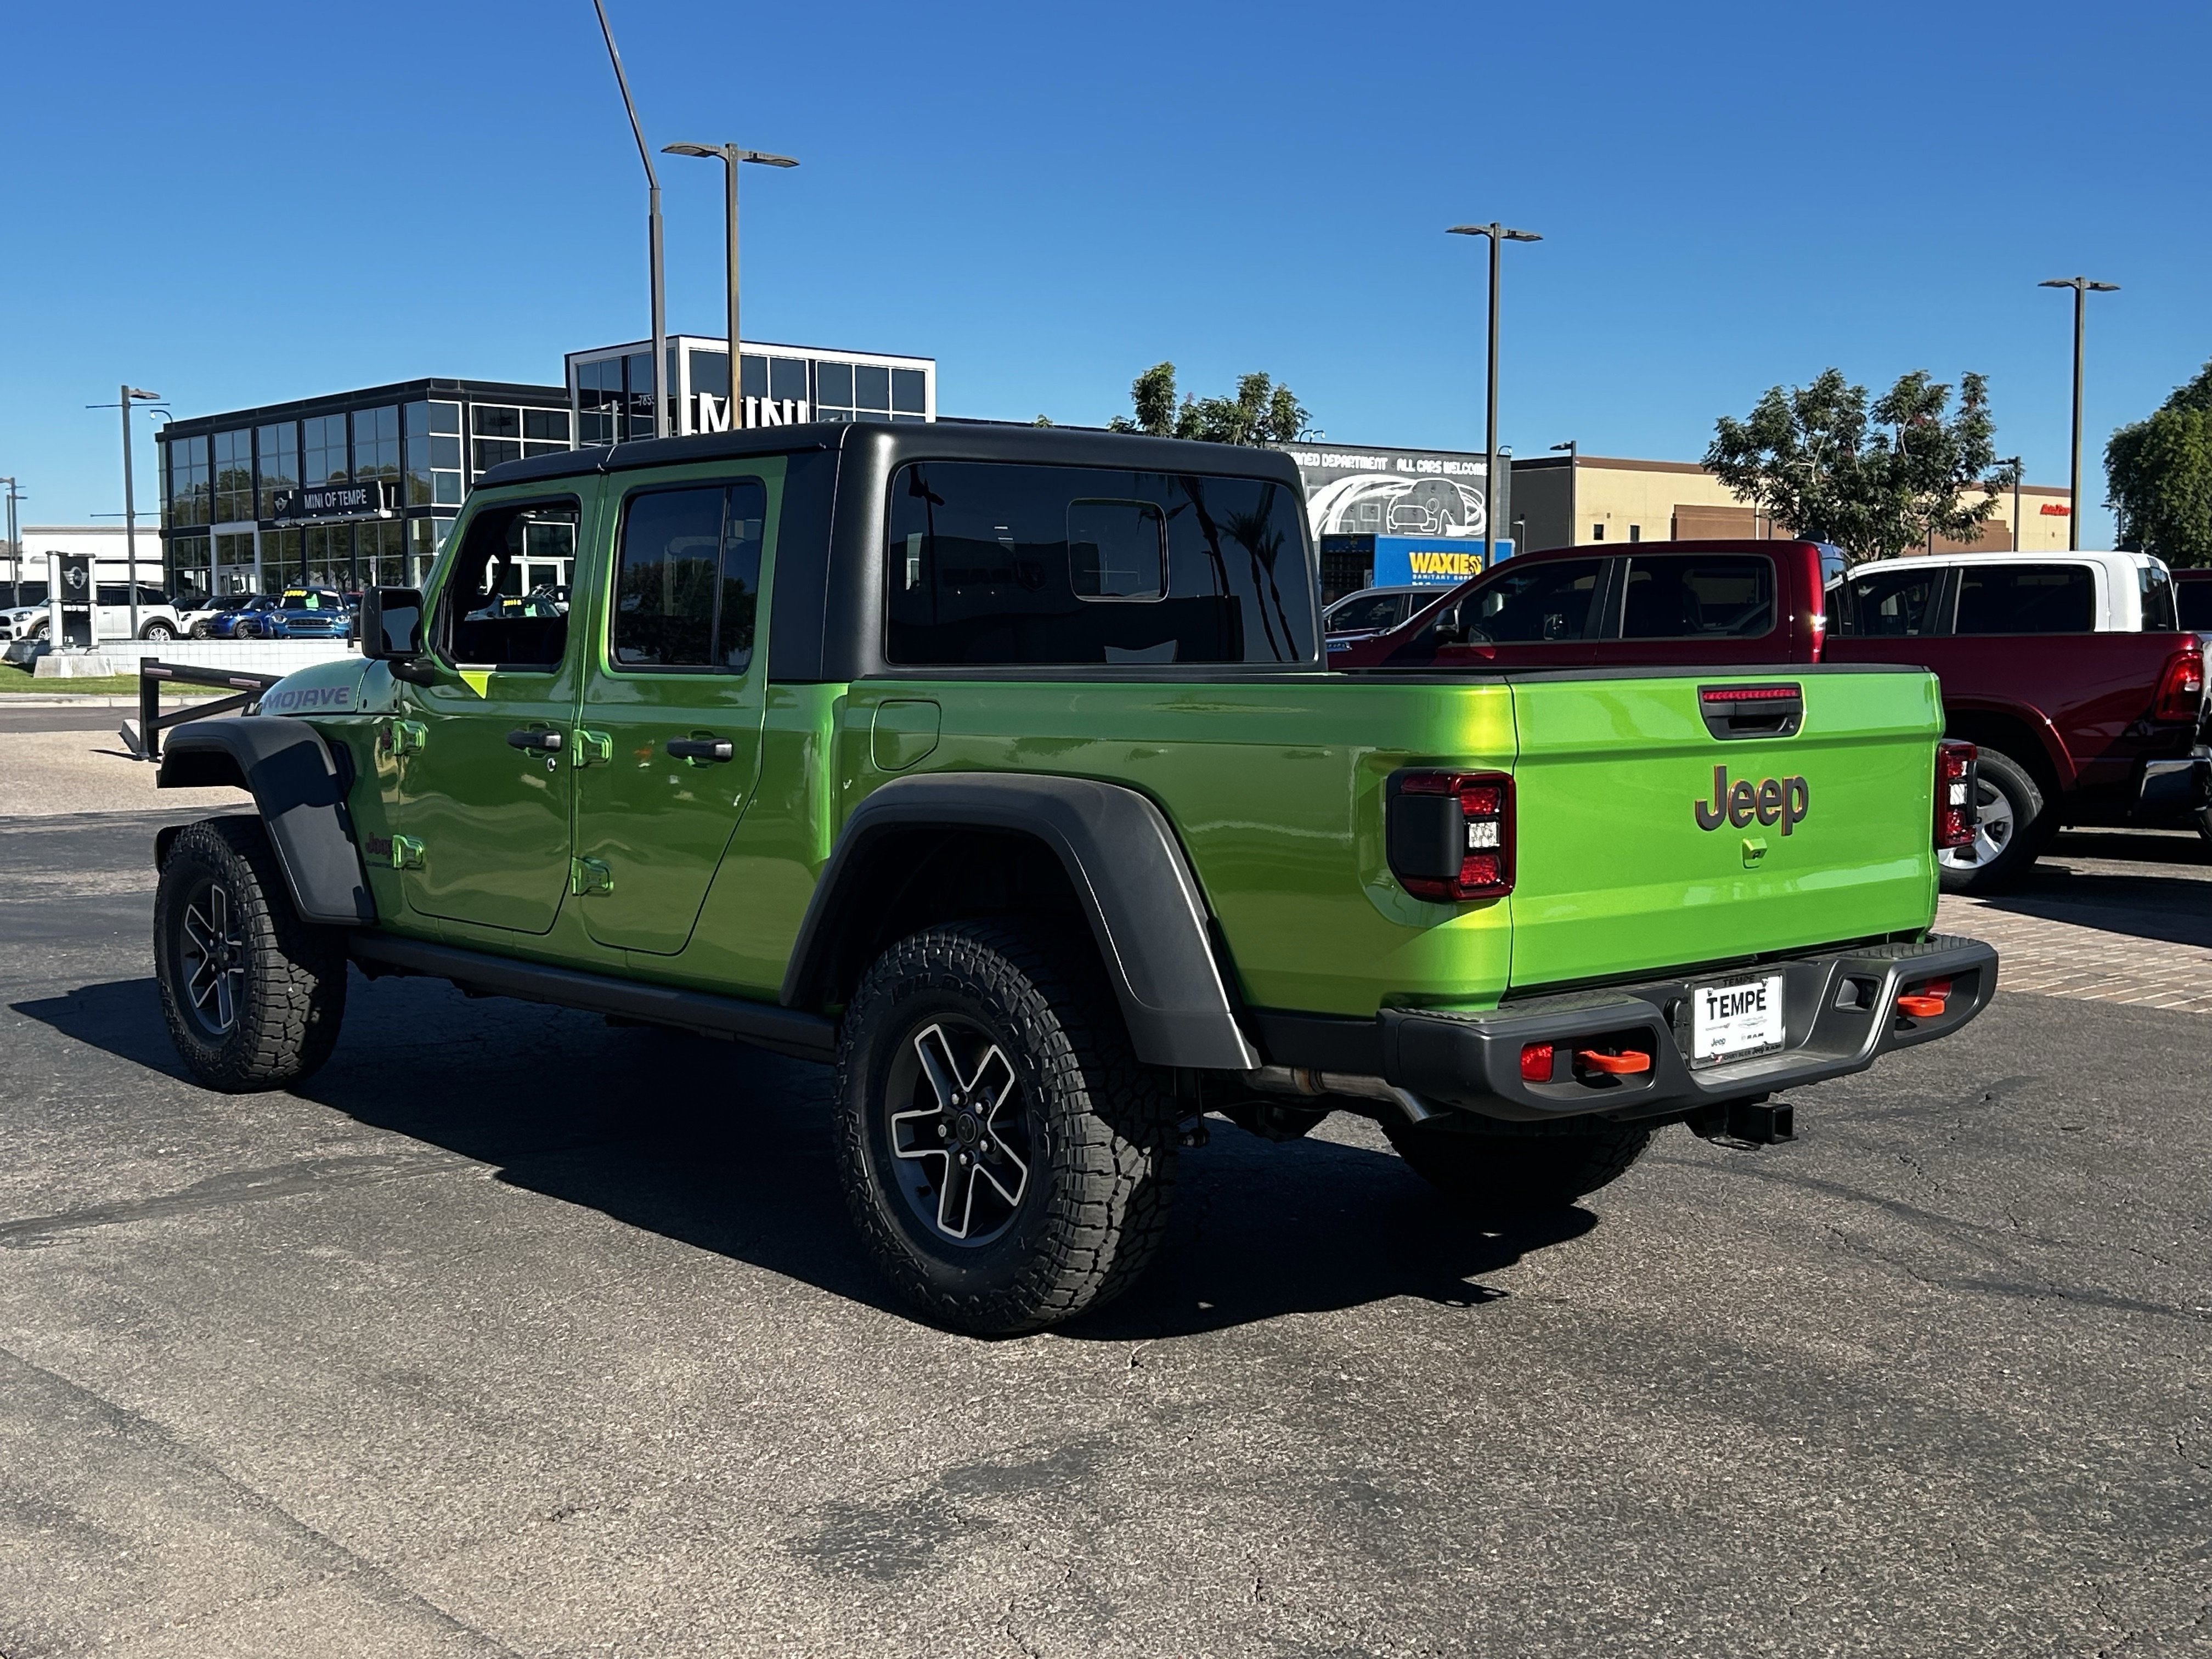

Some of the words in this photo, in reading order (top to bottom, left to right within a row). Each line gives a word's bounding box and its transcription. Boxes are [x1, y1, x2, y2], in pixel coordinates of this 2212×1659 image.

[699, 392, 808, 435] MINI
[1322, 453, 1388, 470] DEPARTMENT
[1397, 458, 1415, 472] ALL
[1417, 460, 1442, 473] CARS
[304, 494, 324, 509] MINI
[325, 492, 337, 507] OF
[337, 489, 368, 506] TEMPE
[263, 687, 350, 710] MOJAVE
[1695, 764, 1809, 837] Jeep
[1723, 975, 1755, 986] TEMPE
[1706, 989, 1767, 1020] TEMPE
